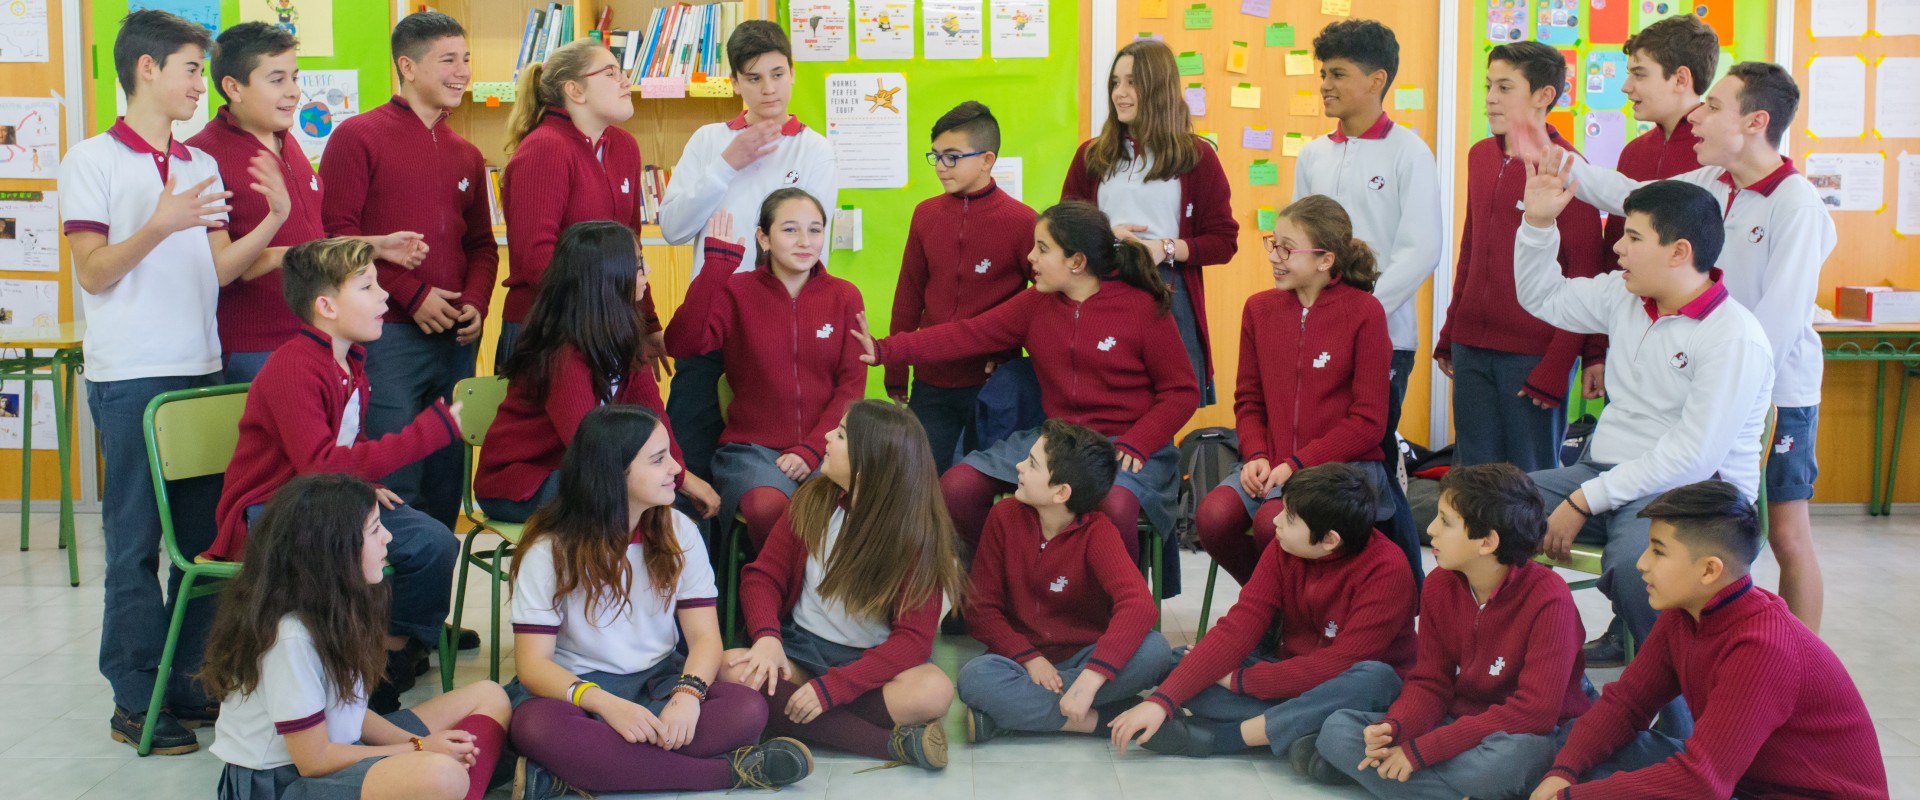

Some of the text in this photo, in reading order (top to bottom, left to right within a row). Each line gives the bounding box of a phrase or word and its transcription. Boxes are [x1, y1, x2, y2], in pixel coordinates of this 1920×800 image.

[832, 80, 857, 88] NORMES
[846, 88, 857, 96] FER
[830, 97, 859, 105] FEINA EN
[836, 106, 854, 114] EQUIP
